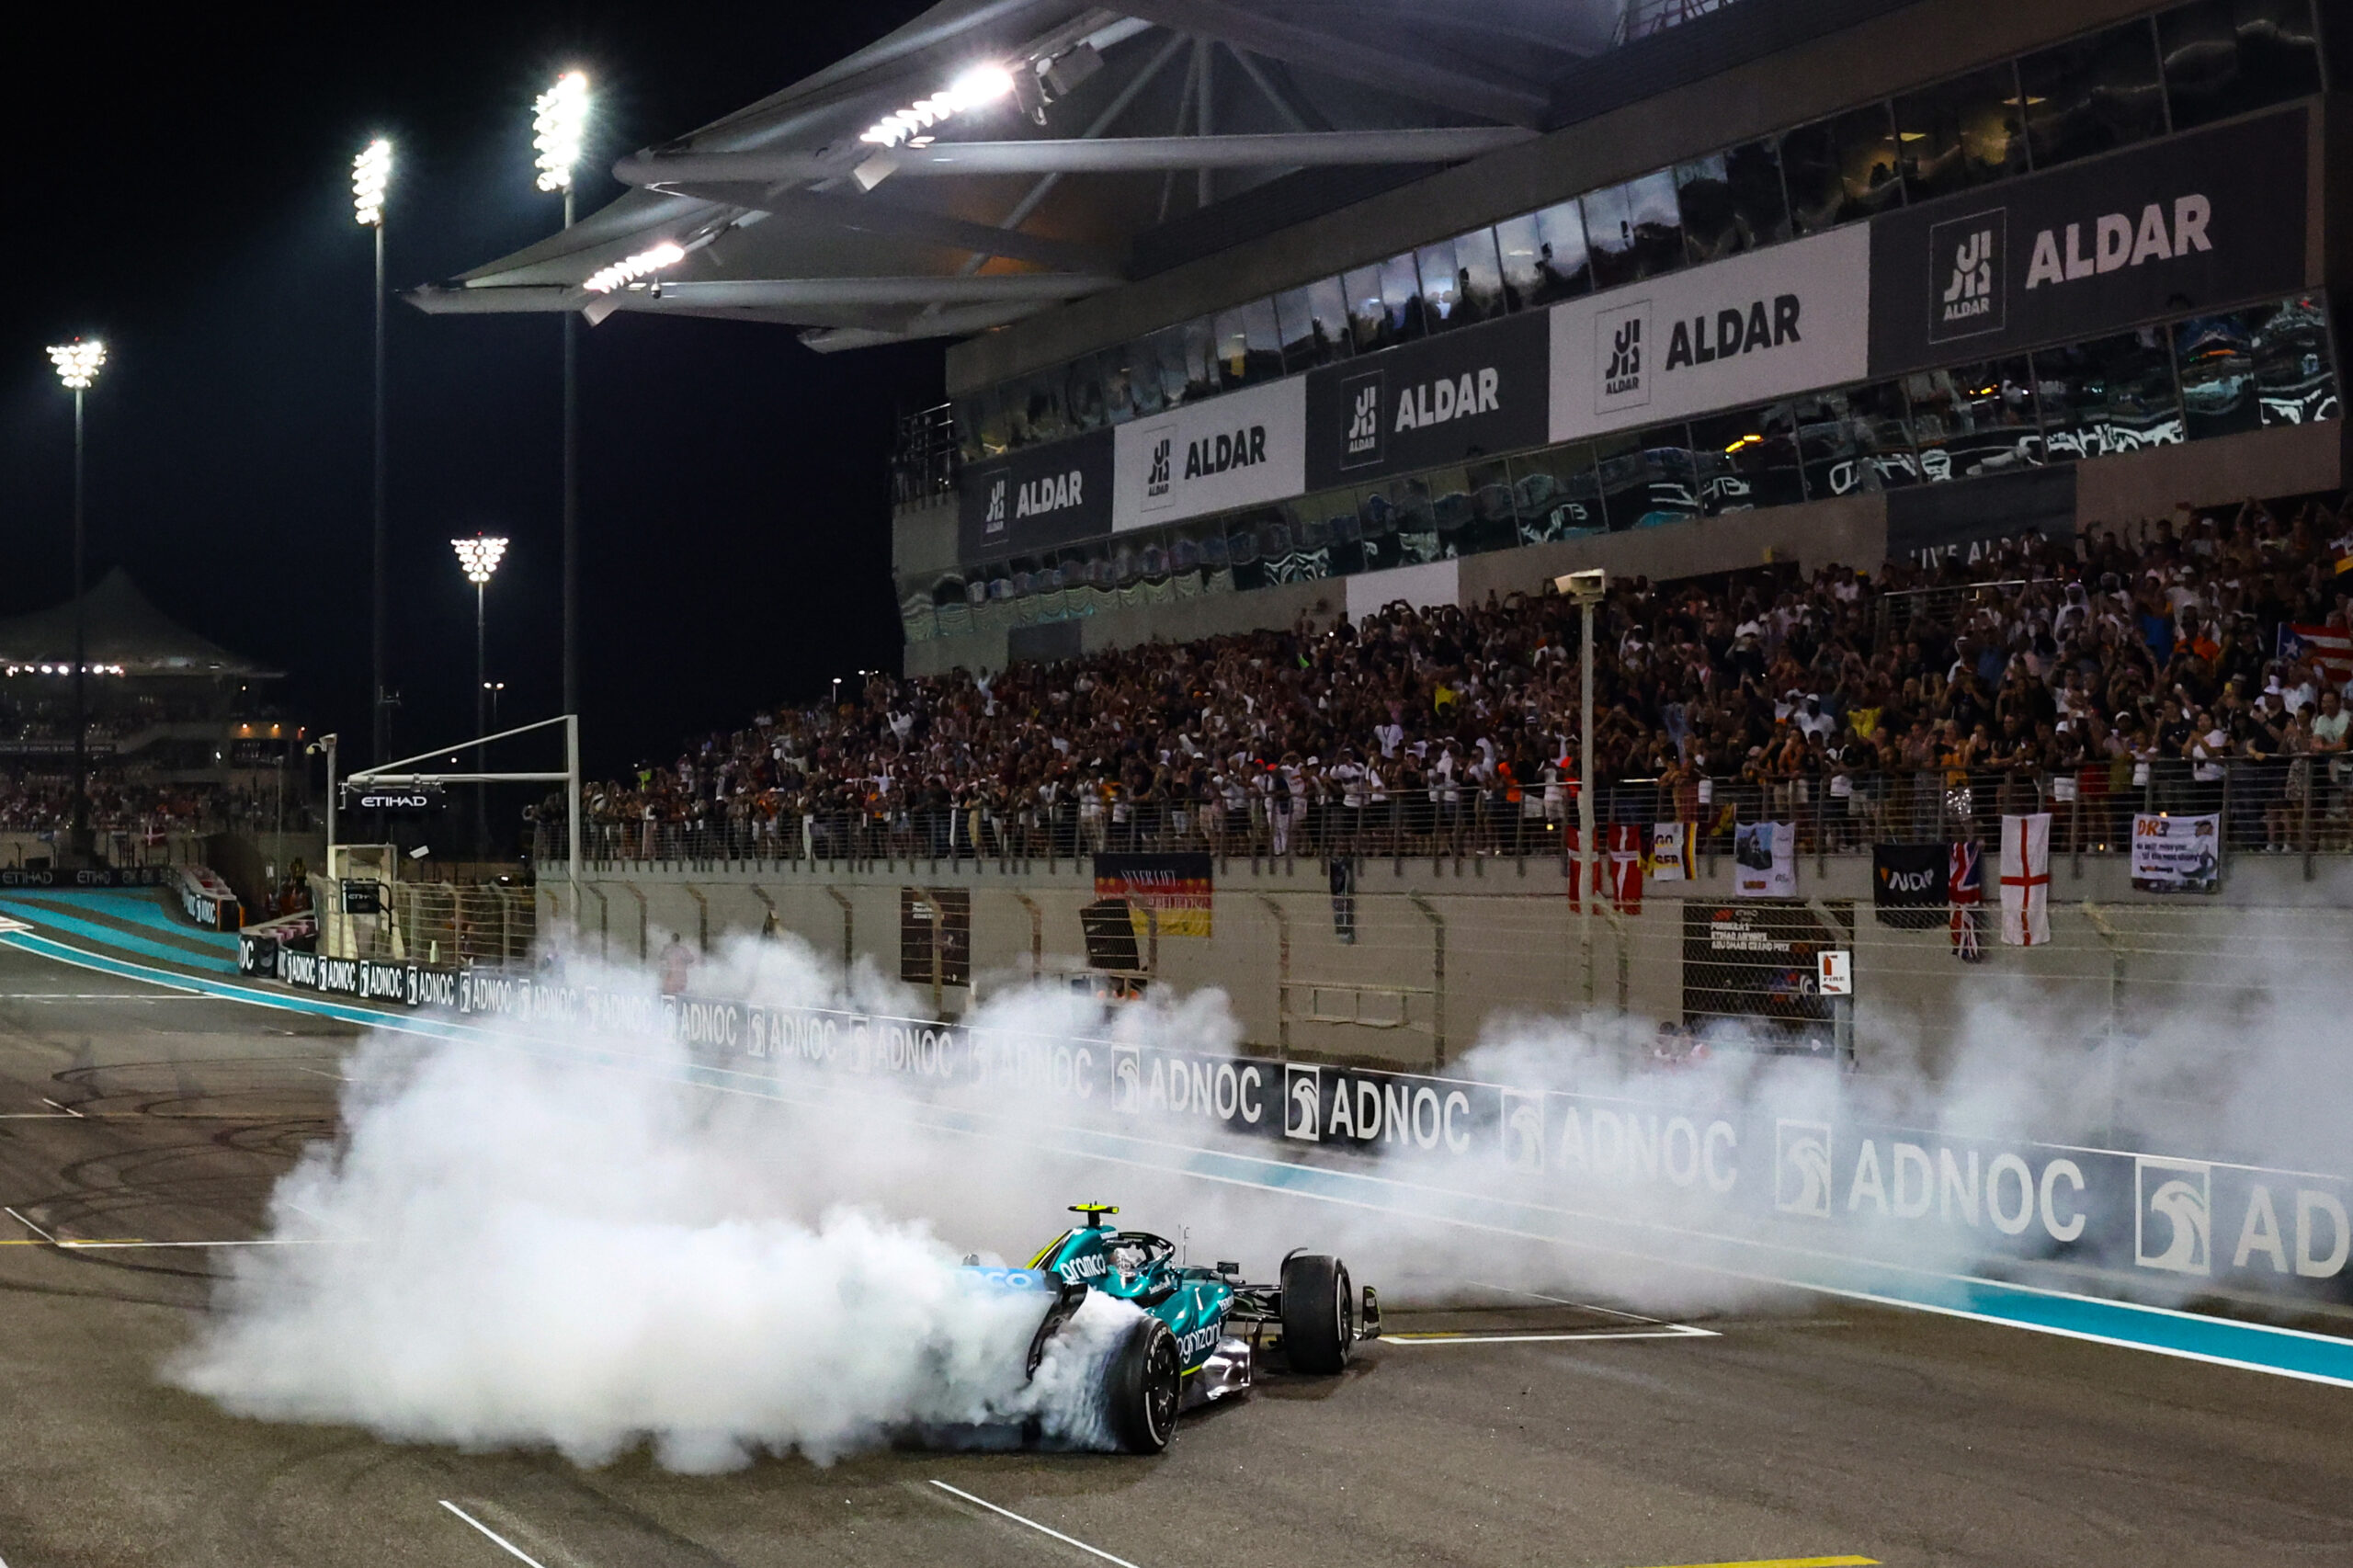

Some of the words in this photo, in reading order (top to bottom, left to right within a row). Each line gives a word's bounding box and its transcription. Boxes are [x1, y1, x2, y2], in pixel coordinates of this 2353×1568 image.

[2025, 194, 2212, 290] ALDAR
[1665, 293, 1802, 371] ALDAR
[1943, 297, 1989, 322] ALDAR
[1394, 367, 1499, 433] ALDAR
[1606, 376, 1639, 395] ALDAR
[1184, 425, 1267, 480] ALDAR
[1348, 436, 1375, 453] ALDAR
[1016, 470, 1083, 518] ALDAR
[361, 796, 426, 807] ETIHAD
[292, 955, 315, 985] ADNOC
[327, 960, 356, 991] ADNOC
[369, 964, 403, 998] ADNOC
[419, 971, 454, 1006] ADNOC
[472, 978, 512, 1012] ADNOC
[534, 985, 577, 1022] ADNOC
[681, 1003, 737, 1046] ADNOC
[769, 1013, 837, 1061] ADNOC
[875, 1026, 953, 1077] ADNOC
[1149, 1057, 1262, 1123] ADNOC
[1328, 1078, 1470, 1154] ADNOC
[1559, 1106, 1737, 1192] ADNOC
[1847, 1139, 2086, 1242] ADNOC
[1060, 1253, 1107, 1281] aramco
[1176, 1317, 1222, 1365] ognizant
